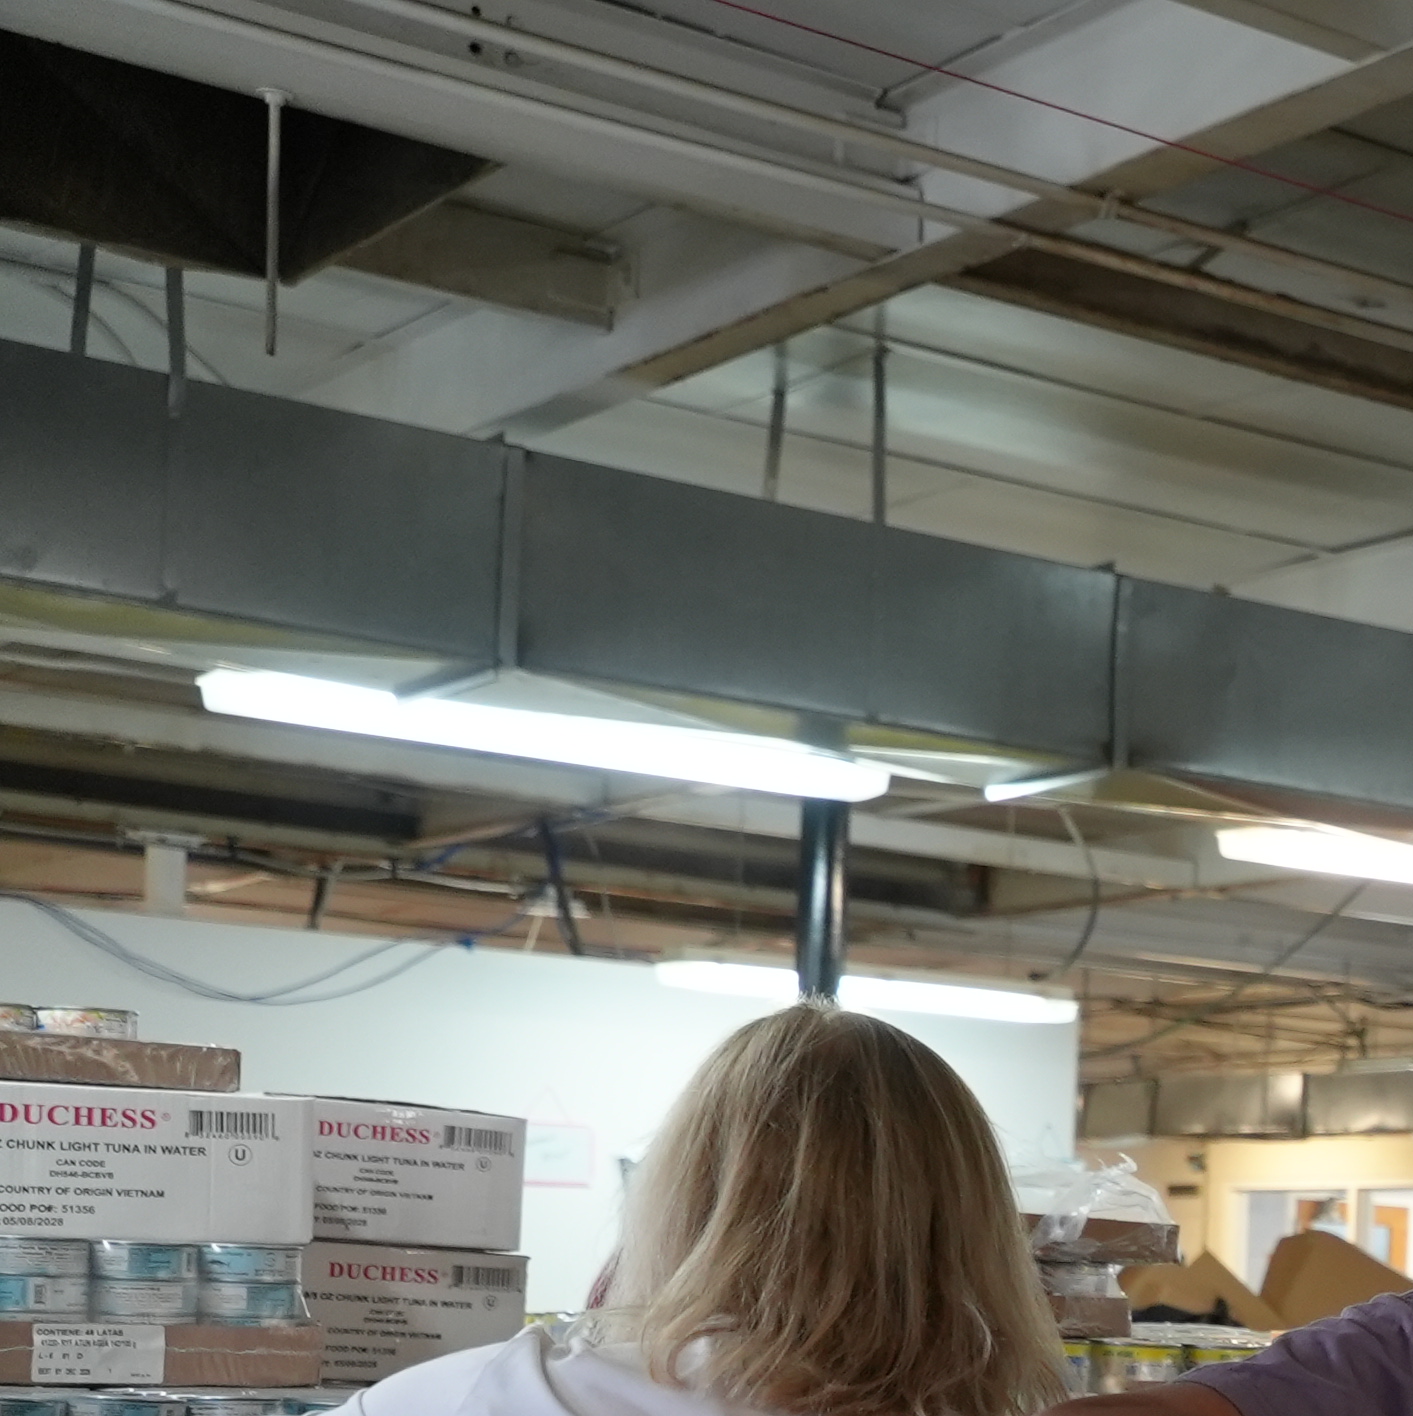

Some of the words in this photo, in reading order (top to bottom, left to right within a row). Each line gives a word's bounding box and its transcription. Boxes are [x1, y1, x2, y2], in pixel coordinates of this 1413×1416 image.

[0, 1103, 157, 1129] DUCHESS
[318, 1120, 431, 1145] DUCHESS
[6, 1139, 55, 1151] CHUNK
[60, 1140, 100, 1153] LIGHT
[104, 1143, 140, 1154] TUNA
[143, 1144, 157, 1155] IN
[161, 1145, 207, 1157] WATER
[56, 1158, 77, 1167] CAN
[79, 1159, 106, 1168] CODE
[362, 1154, 390, 1165] LIGHT
[55, 1186, 71, 1196] OF
[73, 1186, 113, 1197] ORIGIN
[116, 1188, 165, 1198] VIETNAM
[329, 1262, 439, 1285] DUCHESS
